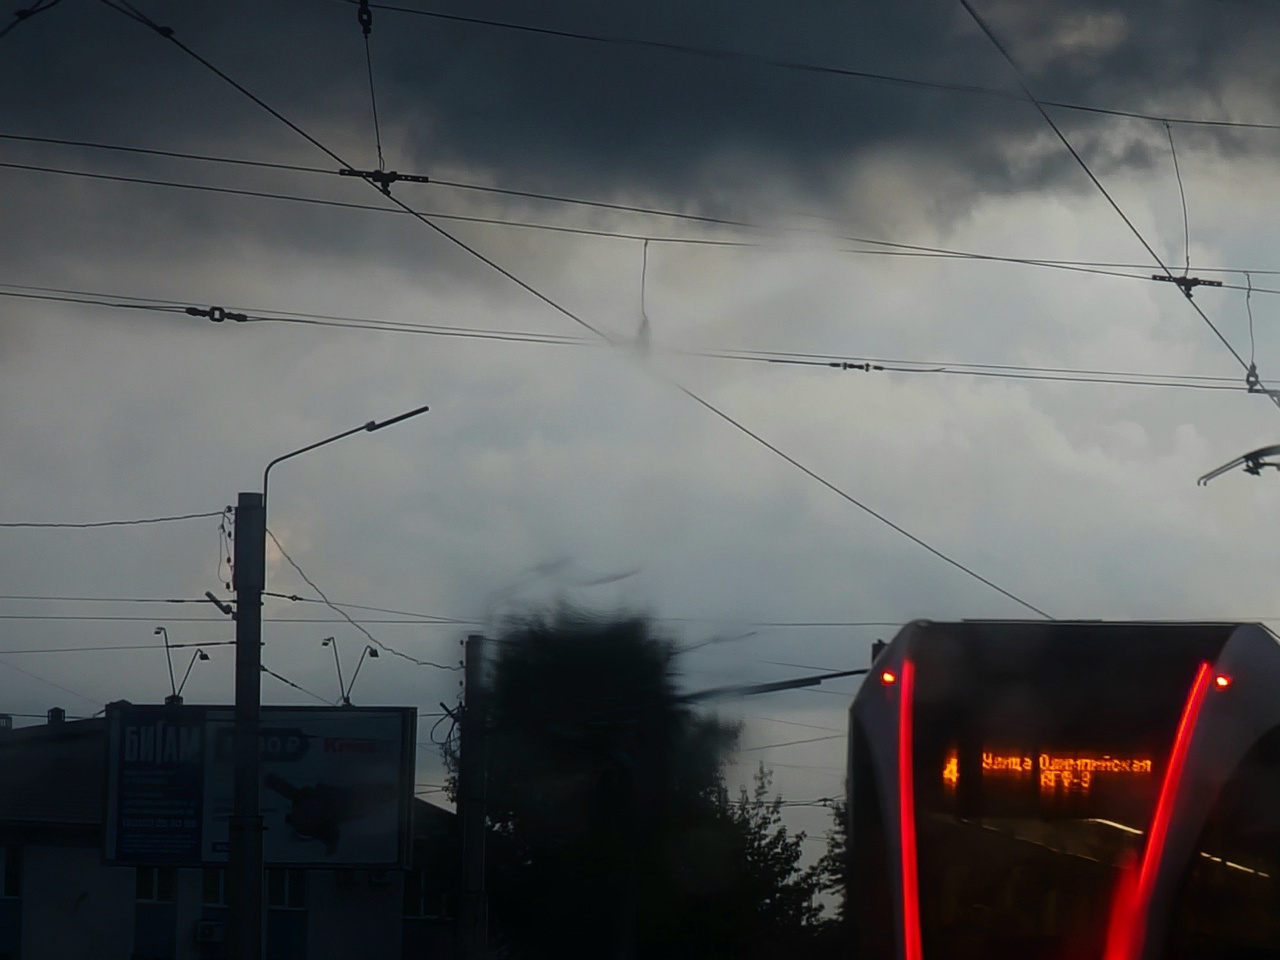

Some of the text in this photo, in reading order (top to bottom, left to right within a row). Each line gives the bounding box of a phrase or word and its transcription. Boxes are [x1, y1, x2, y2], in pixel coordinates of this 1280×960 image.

[124, 721, 200, 765] БИГАМ
[943, 757, 960, 783] 4
[982, 752, 1032, 772] Улица
